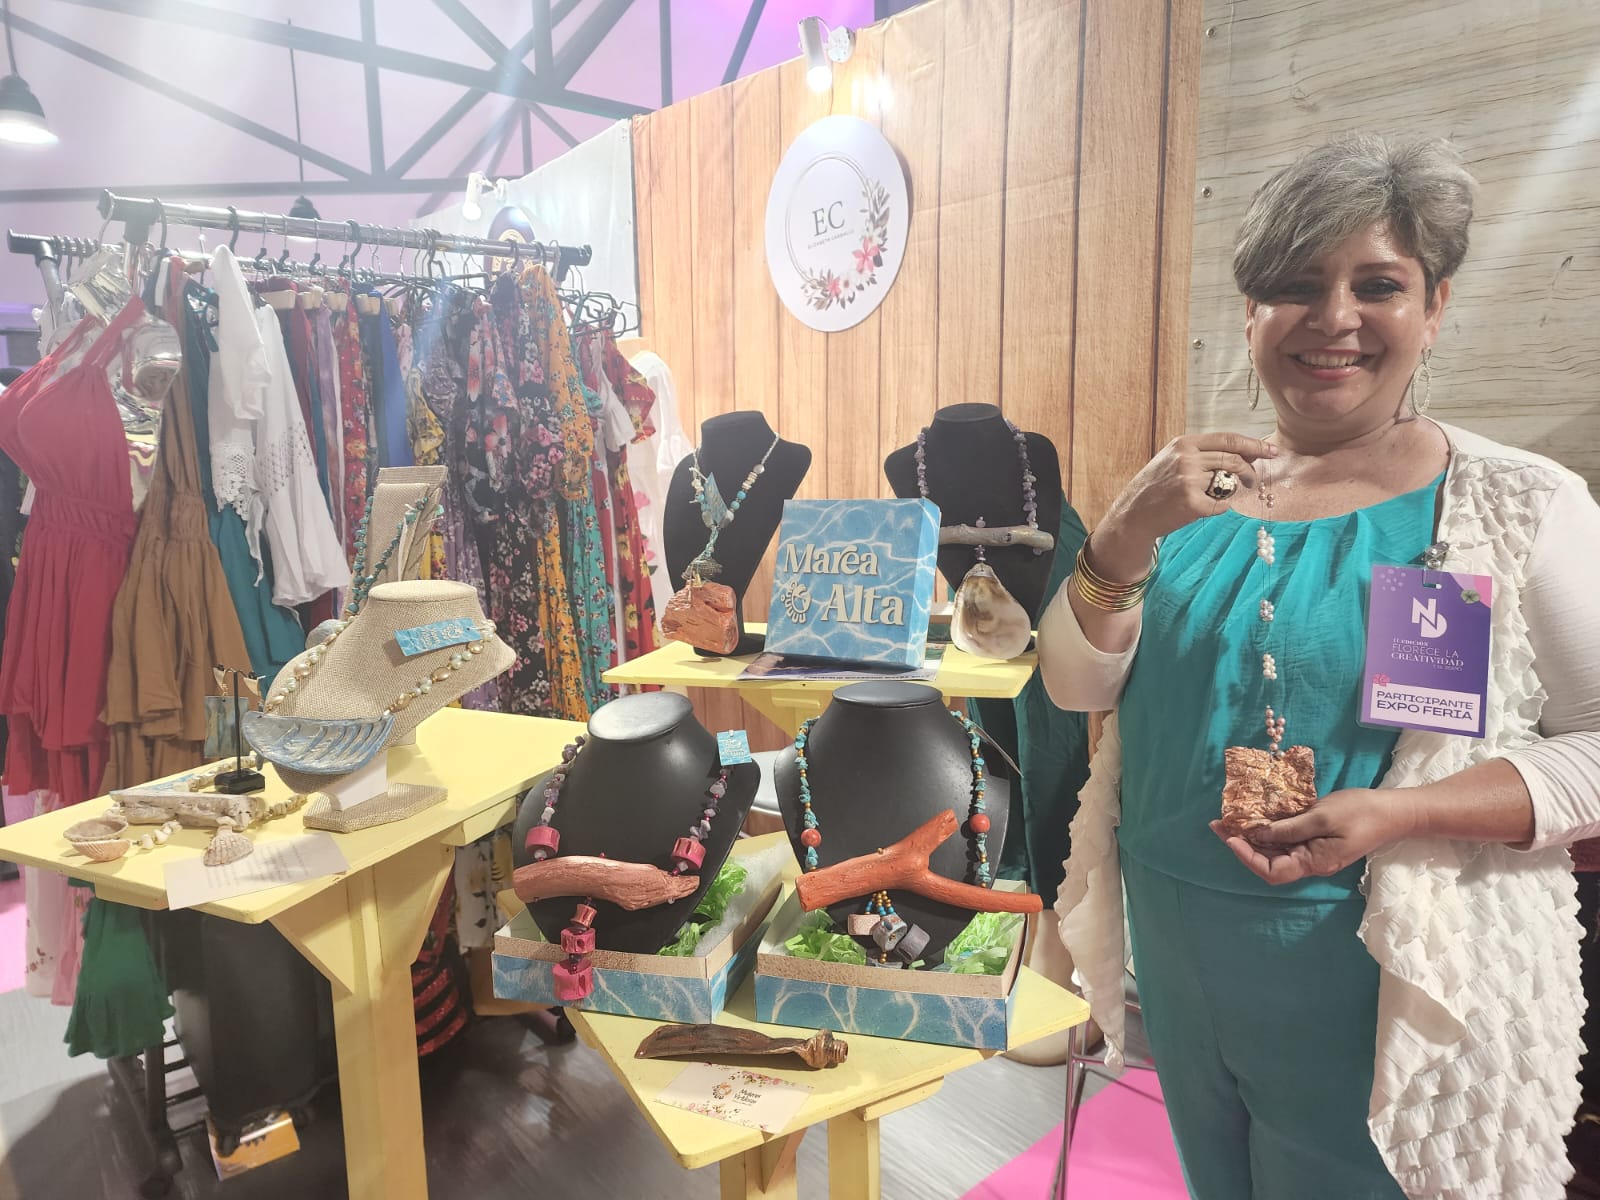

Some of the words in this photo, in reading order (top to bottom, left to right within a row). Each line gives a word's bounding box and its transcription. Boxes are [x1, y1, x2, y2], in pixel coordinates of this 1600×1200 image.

[812, 200, 845, 237] EC
[783, 543, 878, 576] Marea
[820, 583, 904, 626] Alta
[1392, 643, 1440, 656] FLORECE
[1445, 649, 1459, 659] LA
[1376, 690, 1474, 710] PARTICIPANTE
[1377, 700, 1420, 713] EXPO
[1423, 706, 1473, 721] FERIA
